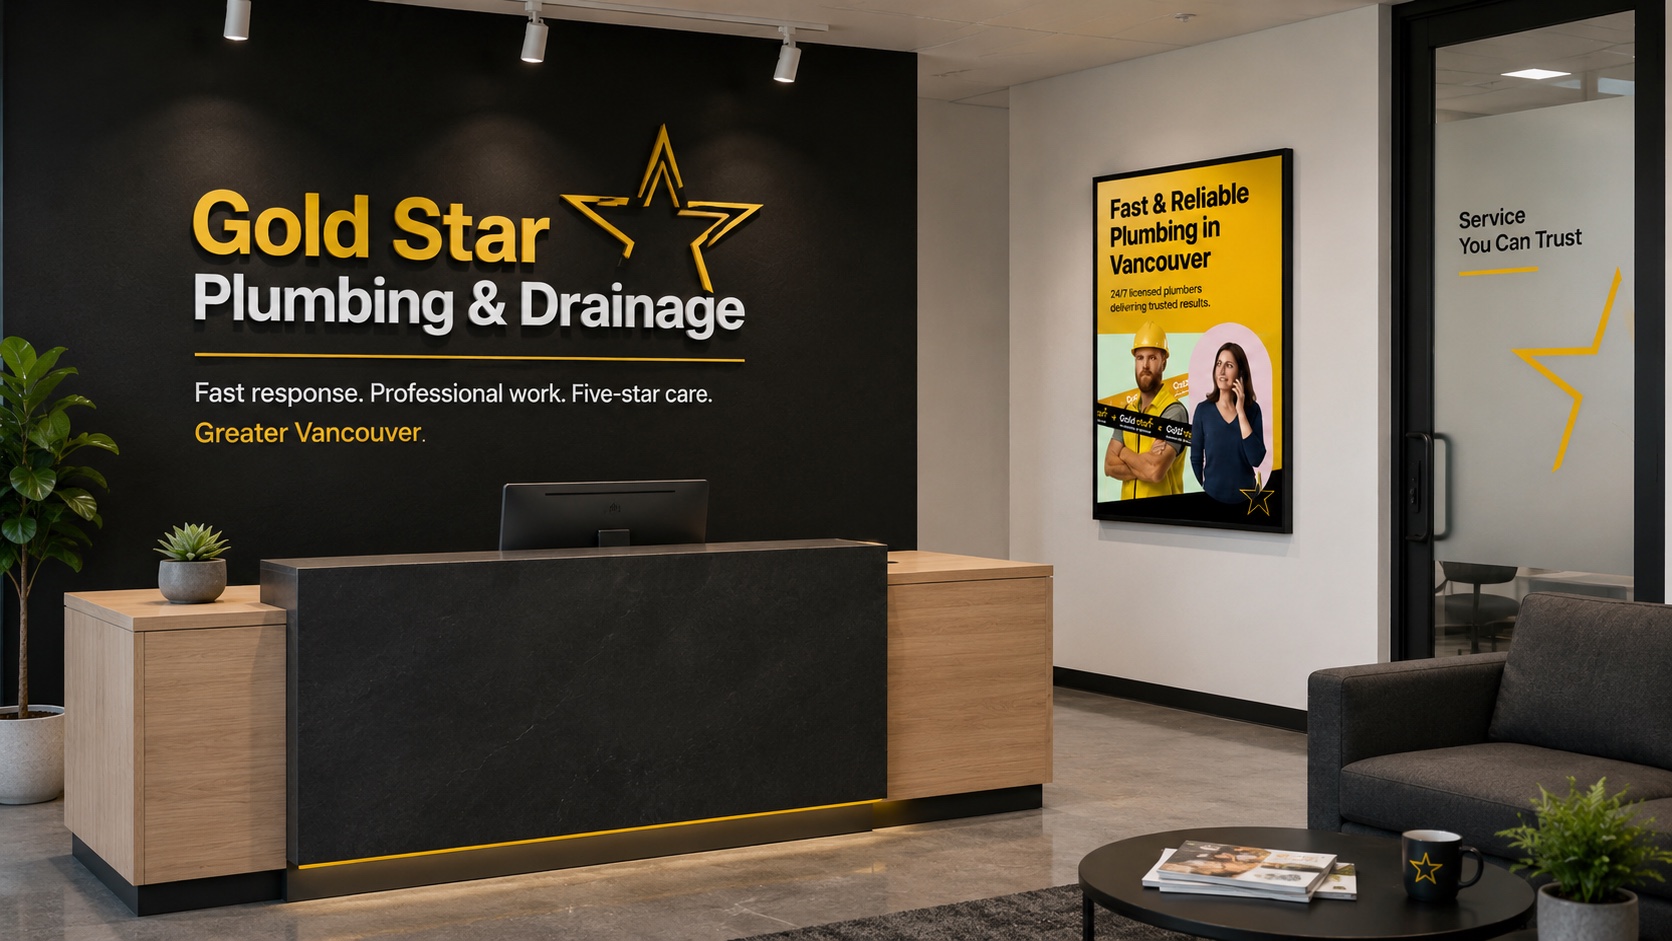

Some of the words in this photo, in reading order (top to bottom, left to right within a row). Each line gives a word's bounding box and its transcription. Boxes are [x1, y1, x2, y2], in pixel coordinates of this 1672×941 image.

[1110, 196, 1149, 220] Fast
[1152, 192, 1167, 215] &
[1171, 182, 1250, 212] Reliable
[192, 188, 370, 260] Gold
[392, 195, 551, 264] Star
[1110, 219, 1199, 248] Plumbing
[1202, 215, 1221, 239] in
[1459, 207, 1526, 229] Service
[1459, 236, 1491, 255] You
[1495, 233, 1531, 252] Can
[1534, 228, 1583, 249] Trust
[1109, 250, 1212, 276] Vancouver
[1110, 288, 1128, 299] 24/7
[1128, 286, 1162, 298] licensed
[1163, 284, 1203, 298] plumbers
[1148, 299, 1178, 311] trusted
[1179, 298, 1211, 309] results.
[194, 272, 455, 337] Plumbing
[467, 279, 509, 326] &
[520, 281, 746, 341] Drainage
[194, 381, 245, 403] Fast
[251, 387, 364, 408] response.
[370, 382, 503, 404] Professional
[509, 383, 566, 404] work.
[571, 383, 660, 404] Five-star
[664, 388, 713, 404] care.
[194, 421, 289, 444] Greater
[294, 421, 427, 444] Vancouver.
